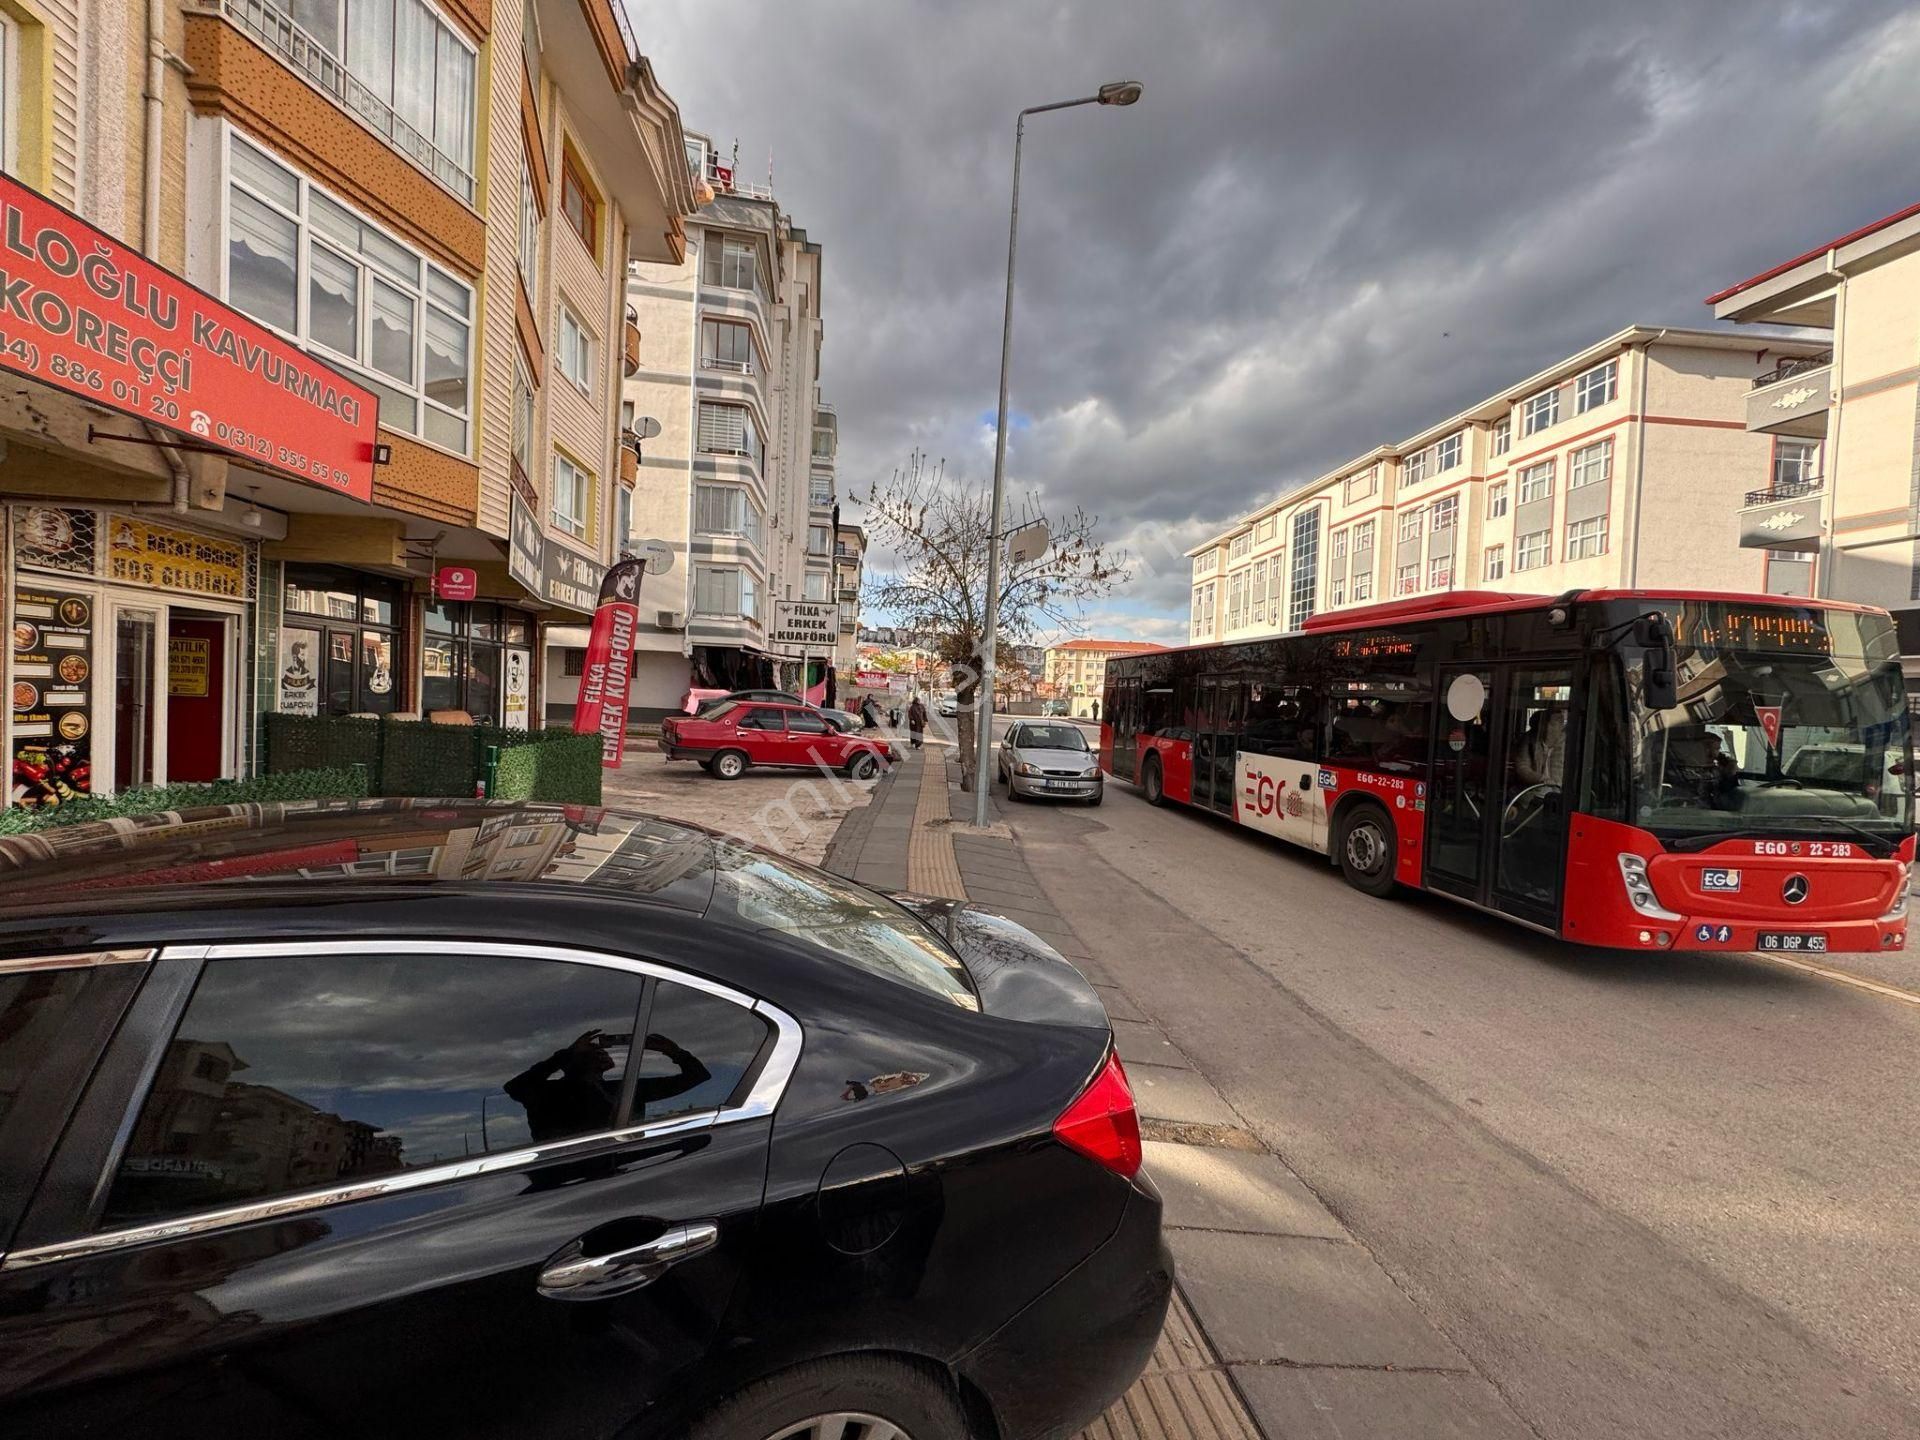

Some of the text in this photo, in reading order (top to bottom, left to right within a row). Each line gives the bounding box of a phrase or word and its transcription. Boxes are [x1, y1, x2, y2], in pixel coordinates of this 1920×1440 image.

[0, 199, 360, 427] LOĞLU KAVURMACI
[0, 269, 192, 395] KOREÇÇİ
[50, 354, 104, 391] 886
[112, 379, 140, 406] 01
[150, 395, 180, 420] 20
[216, 422, 273, 460] 0(312)
[278, 447, 307, 471] 355
[311, 460, 329, 479] 55
[332, 470, 349, 487] 99
[794, 604, 820, 617] FİLKA
[787, 618, 827, 630] ERKEK
[777, 630, 836, 643] KUAFÖRÜ
[604, 609, 634, 700] KUAFÖRÜ
[584, 663, 606, 704] FİLKA
[1357, 773, 1404, 790] EGO-22-283
[1755, 842, 1787, 855] EGO
[1810, 843, 1851, 857] 22-283
[1704, 873, 1739, 886] EGO
[1765, 935, 1826, 950] 06 DGP 455
